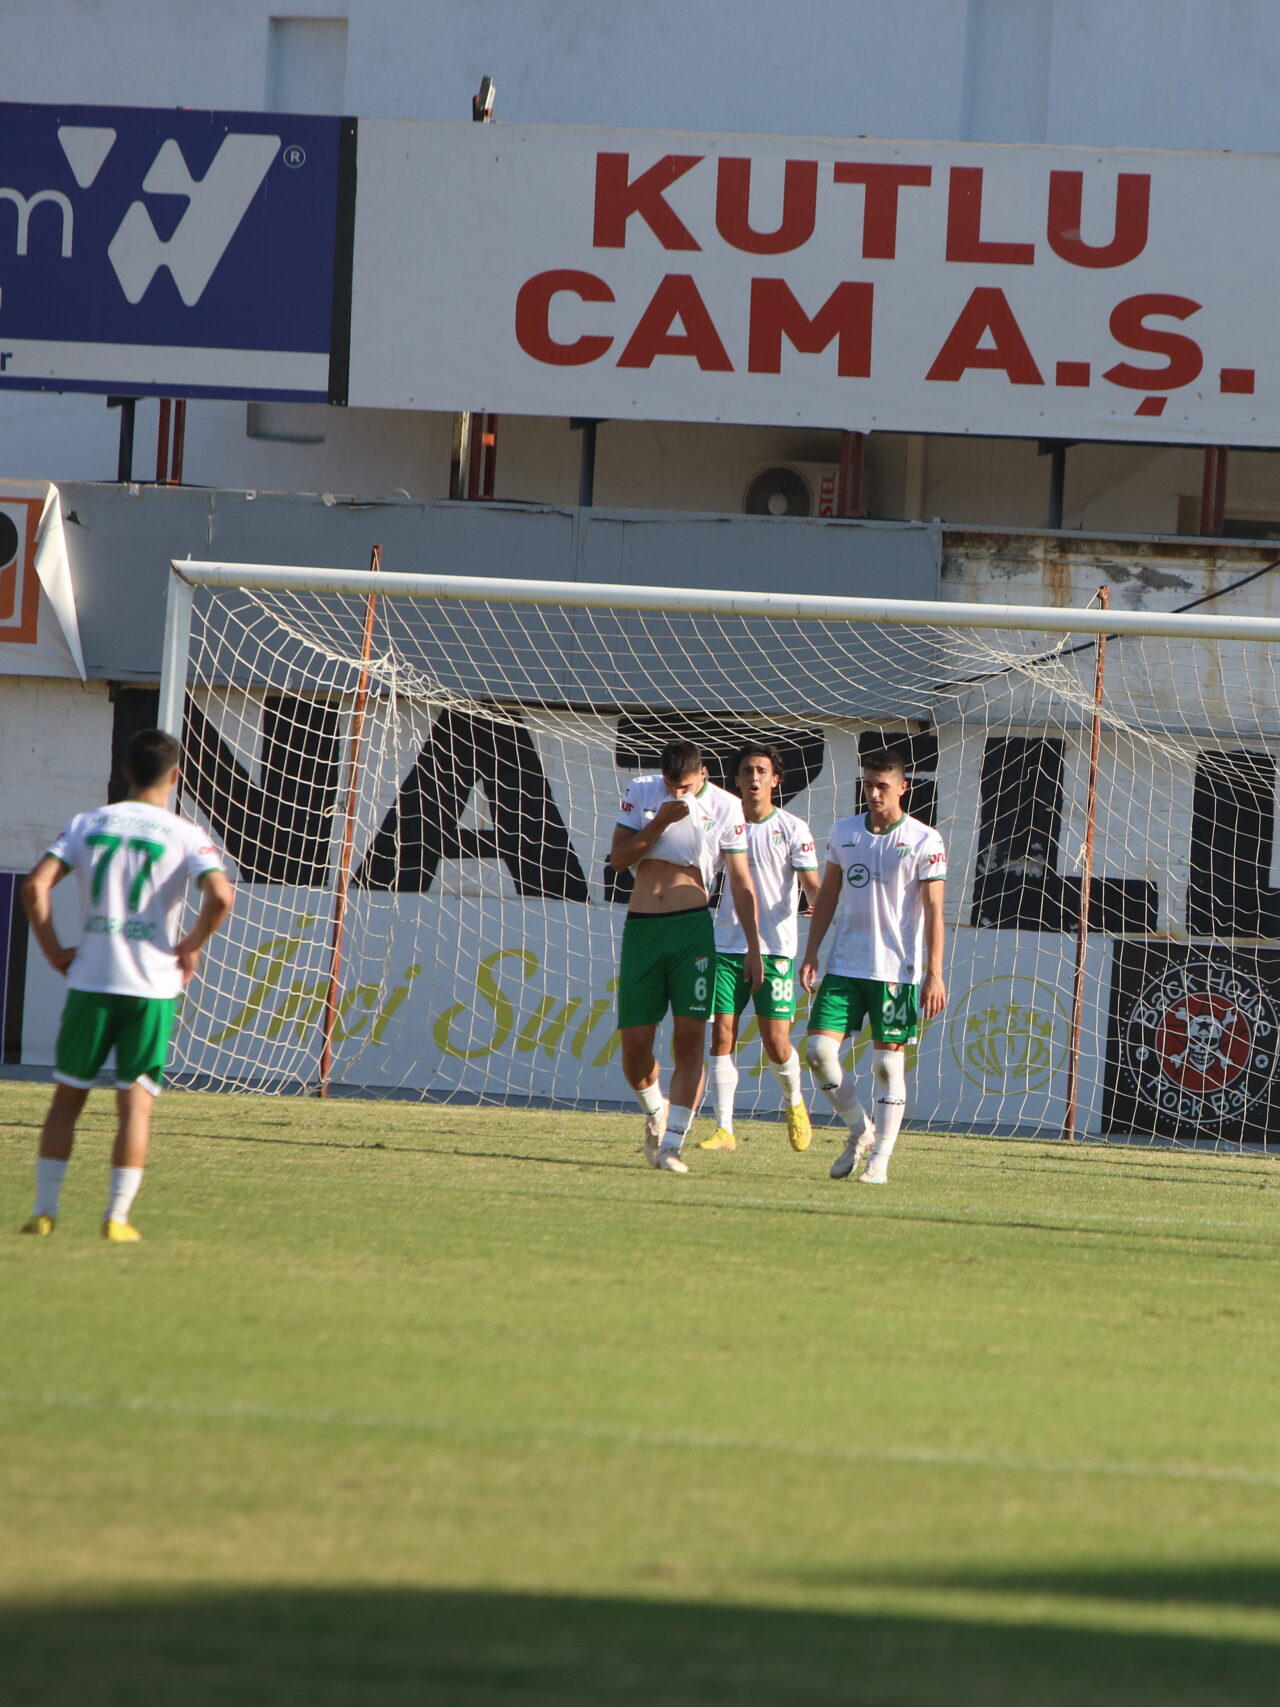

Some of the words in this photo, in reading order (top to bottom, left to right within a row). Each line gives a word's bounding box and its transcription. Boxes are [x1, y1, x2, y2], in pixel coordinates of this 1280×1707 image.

[593, 151, 1151, 269] KUTLU
[515, 268, 874, 378] CAM
[924, 286, 1255, 416] A.Ş.
[85, 833, 166, 913] 77
[694, 976, 707, 1001] 6
[771, 977, 793, 1002] 88
[882, 999, 907, 1025] 94
[1206, 968, 1271, 1038] House
[1147, 1074, 1203, 1117] Rock
[1210, 1081, 1252, 1116] Bar
